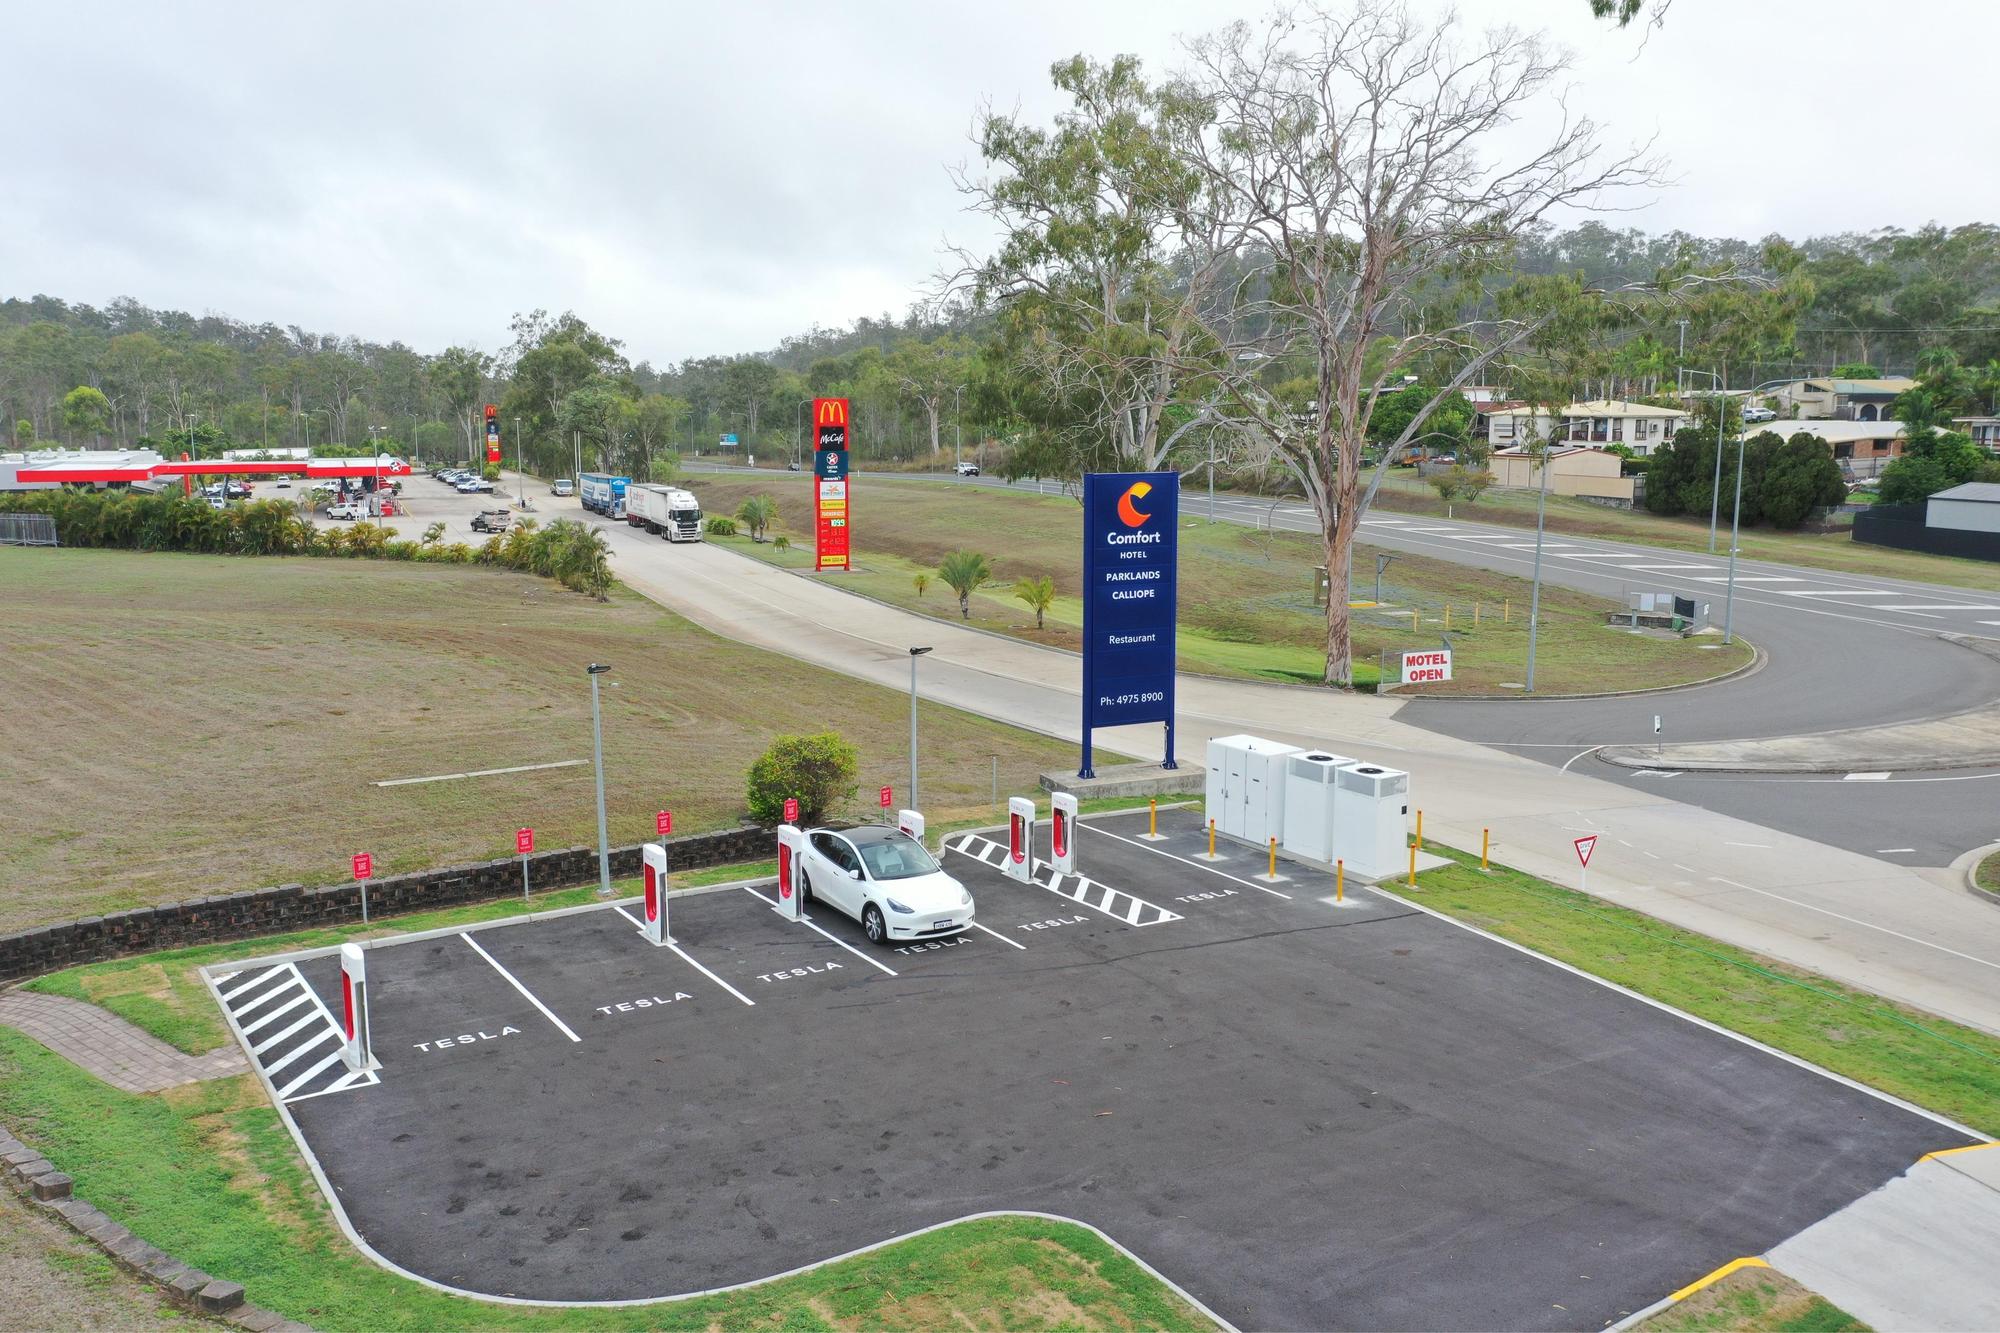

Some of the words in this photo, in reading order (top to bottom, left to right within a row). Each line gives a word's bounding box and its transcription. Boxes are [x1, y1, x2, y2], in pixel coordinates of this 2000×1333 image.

[1107, 530, 1161, 545] Comfort
[1120, 551, 1147, 559] HOTEL
[1106, 570, 1161, 582] PARKLANDS
[1112, 589, 1155, 600] CALLIOPE
[1109, 633, 1156, 645] Restaurant
[1406, 653, 1448, 667] MOTEL
[1409, 668, 1444, 682] OPEN
[1100, 696, 1115, 706] Ph:
[1116, 693, 1139, 705] 4975
[1141, 691, 1164, 703] 8900
[1175, 889, 1239, 904] TESLA
[1017, 915, 1090, 932] TESLA
[894, 936, 974, 955] TESLA
[756, 961, 844, 983] TESLA
[596, 991, 693, 1015] TESLA
[413, 1025, 522, 1052] TESLA
